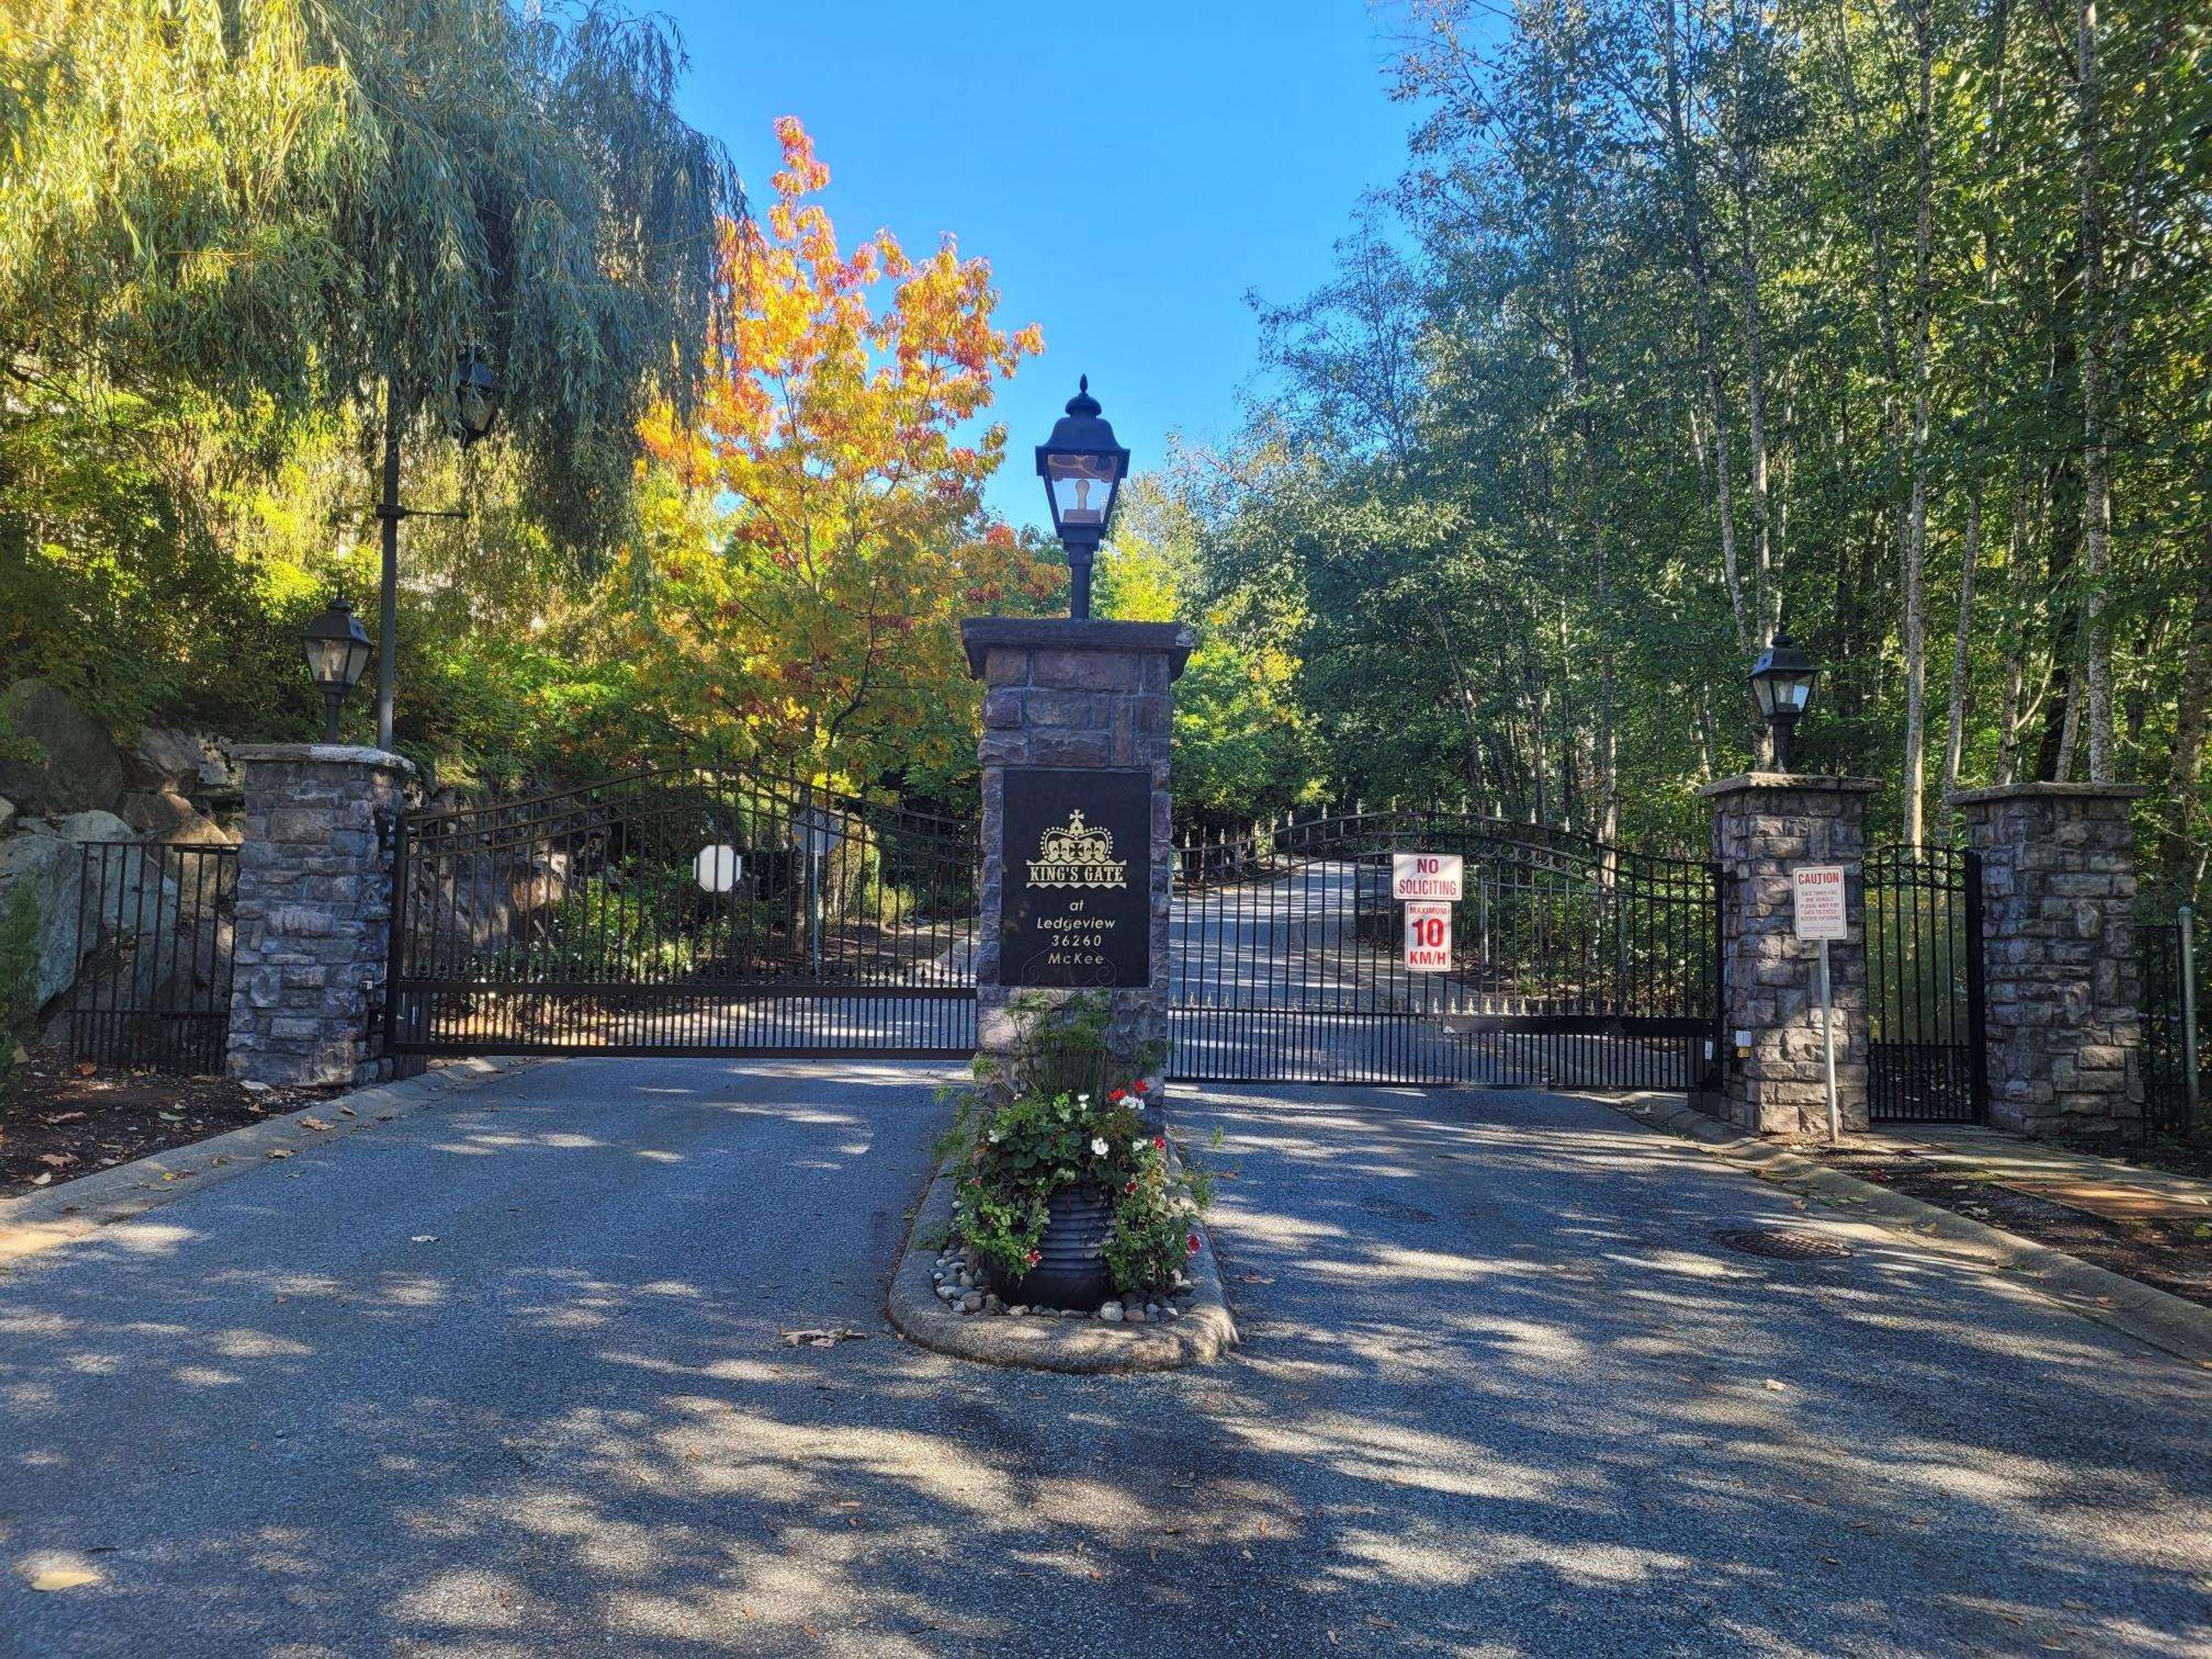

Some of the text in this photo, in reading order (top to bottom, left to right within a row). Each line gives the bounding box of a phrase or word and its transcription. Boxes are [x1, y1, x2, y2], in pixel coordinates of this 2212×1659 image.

[1417, 858, 1439, 874] NO
[1029, 866, 1123, 882] KING'S GATE
[1798, 872, 1839, 885] CAUTION
[1399, 879, 1457, 895] SOLICITING
[1070, 899, 1084, 911] at
[1410, 907, 1448, 915] MAXIMUM
[1037, 916, 1116, 931] Ledgeview
[1412, 918, 1445, 948] 10
[1051, 934, 1102, 947] 36260
[1047, 952, 1104, 965] McKee
[1410, 951, 1446, 965] KM/H
